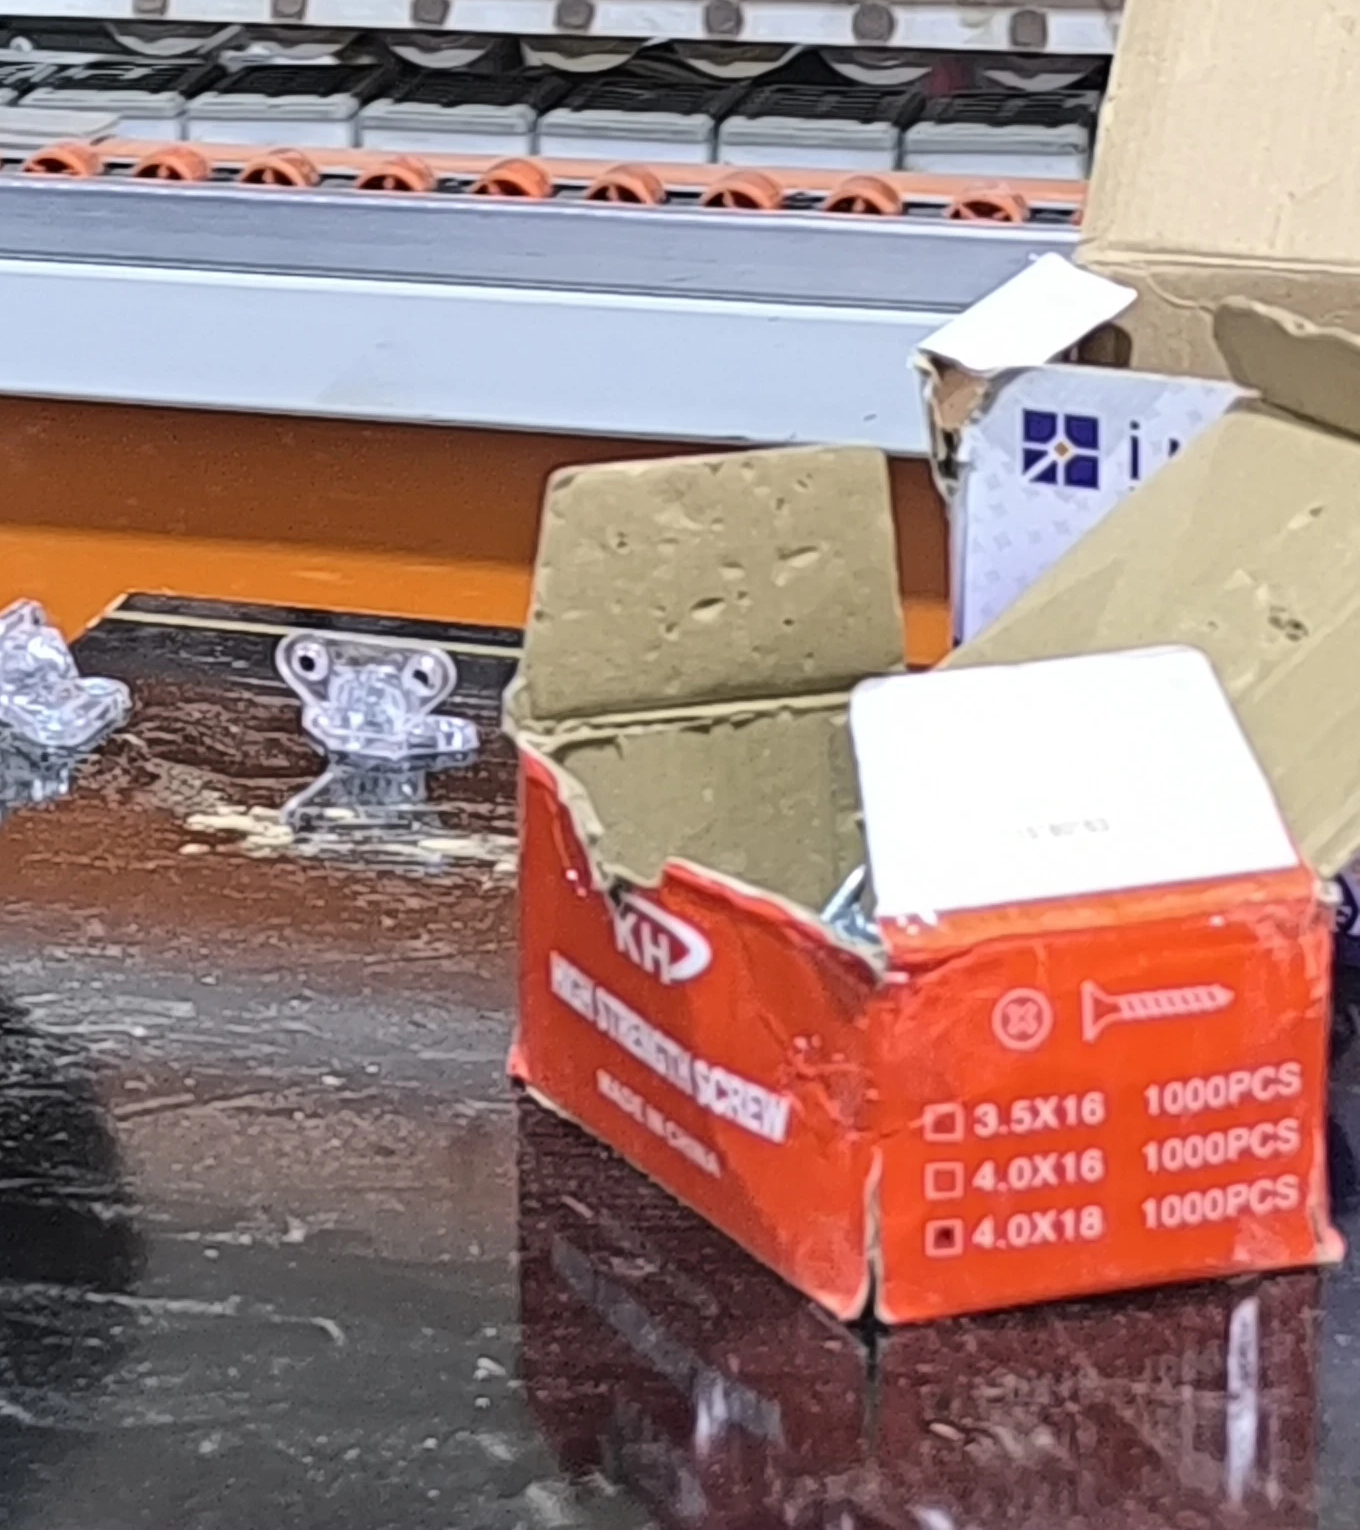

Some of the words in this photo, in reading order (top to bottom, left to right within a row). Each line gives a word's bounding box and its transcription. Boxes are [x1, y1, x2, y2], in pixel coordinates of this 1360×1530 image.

[973, 1090, 1106, 1139] 3.5X16
[1142, 1062, 1302, 1117] 1000PCS
[972, 1148, 1106, 1192] 4.0X16
[1141, 1118, 1301, 1173] 1000PCS
[972, 1205, 1105, 1250] 4.0X18
[1141, 1174, 1300, 1230] 1000PCS
